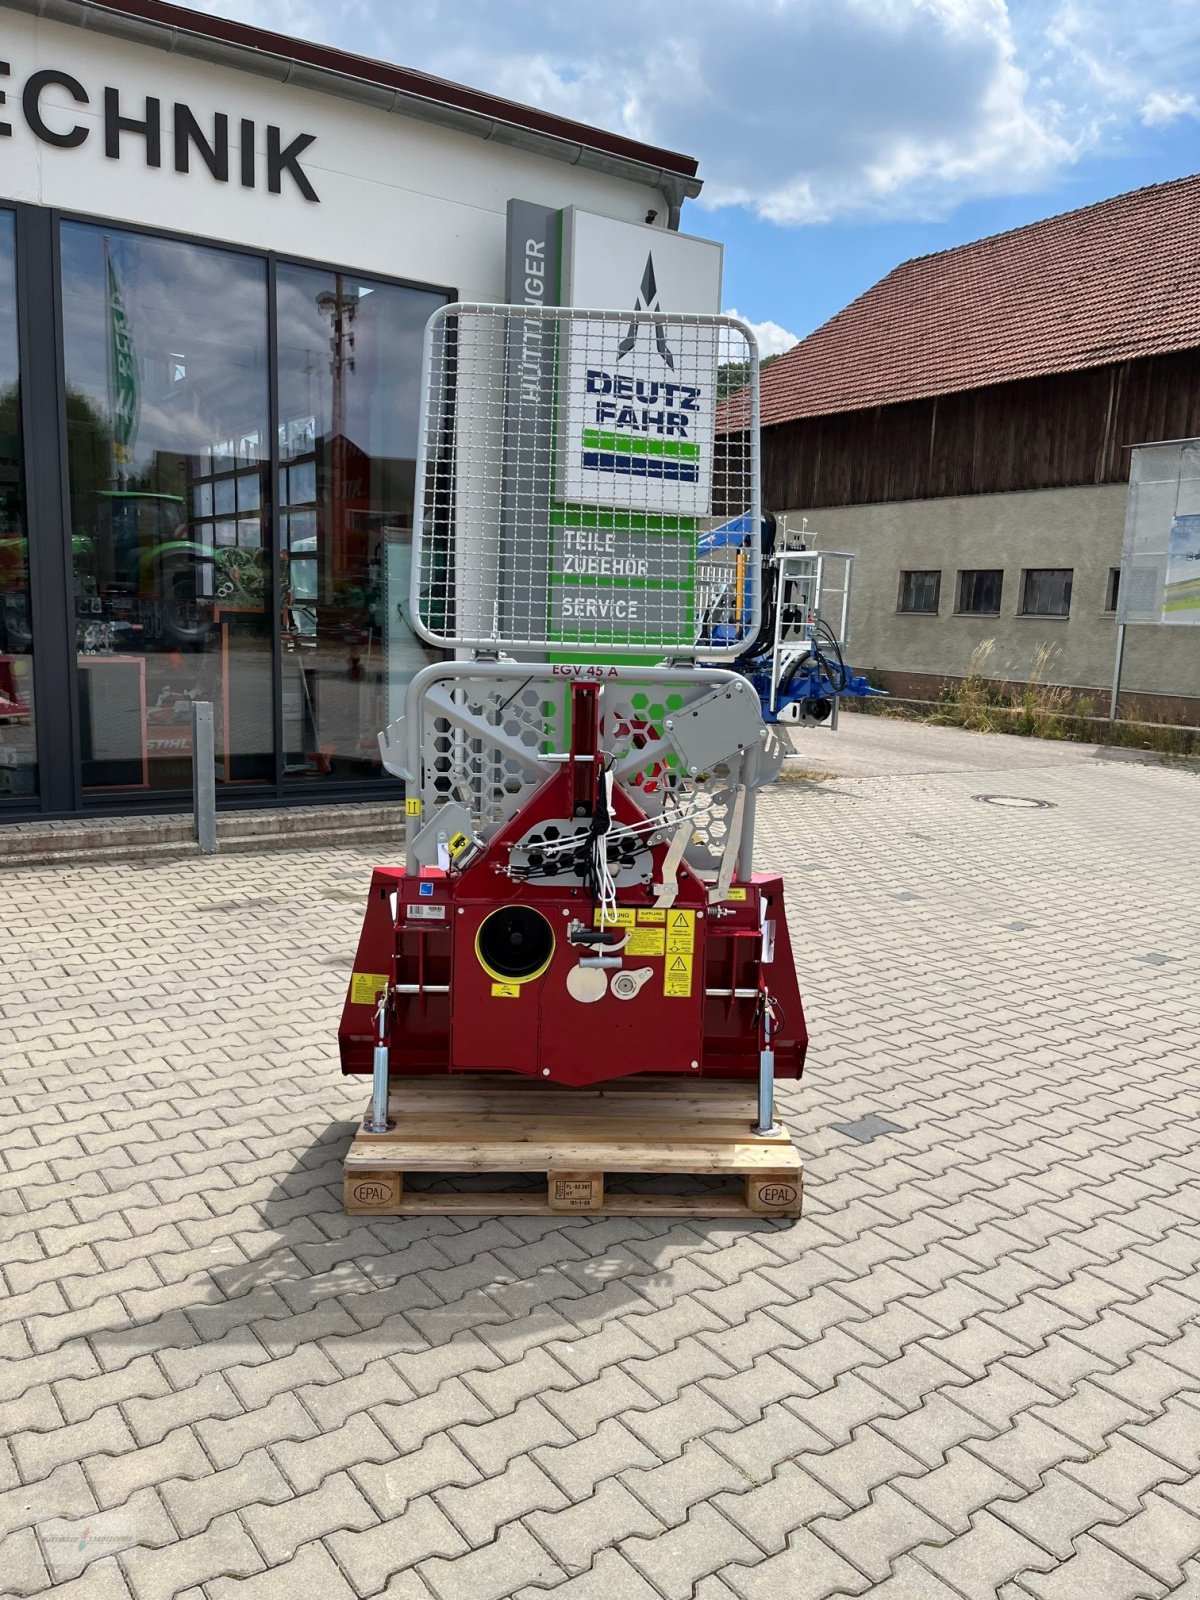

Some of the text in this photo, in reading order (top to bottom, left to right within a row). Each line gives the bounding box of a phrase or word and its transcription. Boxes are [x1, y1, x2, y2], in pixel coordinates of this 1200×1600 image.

[0, 61, 320, 203] CHNIK
[586, 370, 701, 411] DEUTZ
[596, 401, 689, 437] FAHR
[564, 531, 615, 552] TEILE
[563, 553, 648, 576] ZUBEHÖR
[562, 597, 638, 618] SERVICE
[552, 664, 618, 676] EGV 45 A
[147, 739, 191, 750] STIHL
[360, 1186, 386, 1200] EPAL
[765, 1188, 792, 1201] EPAL
